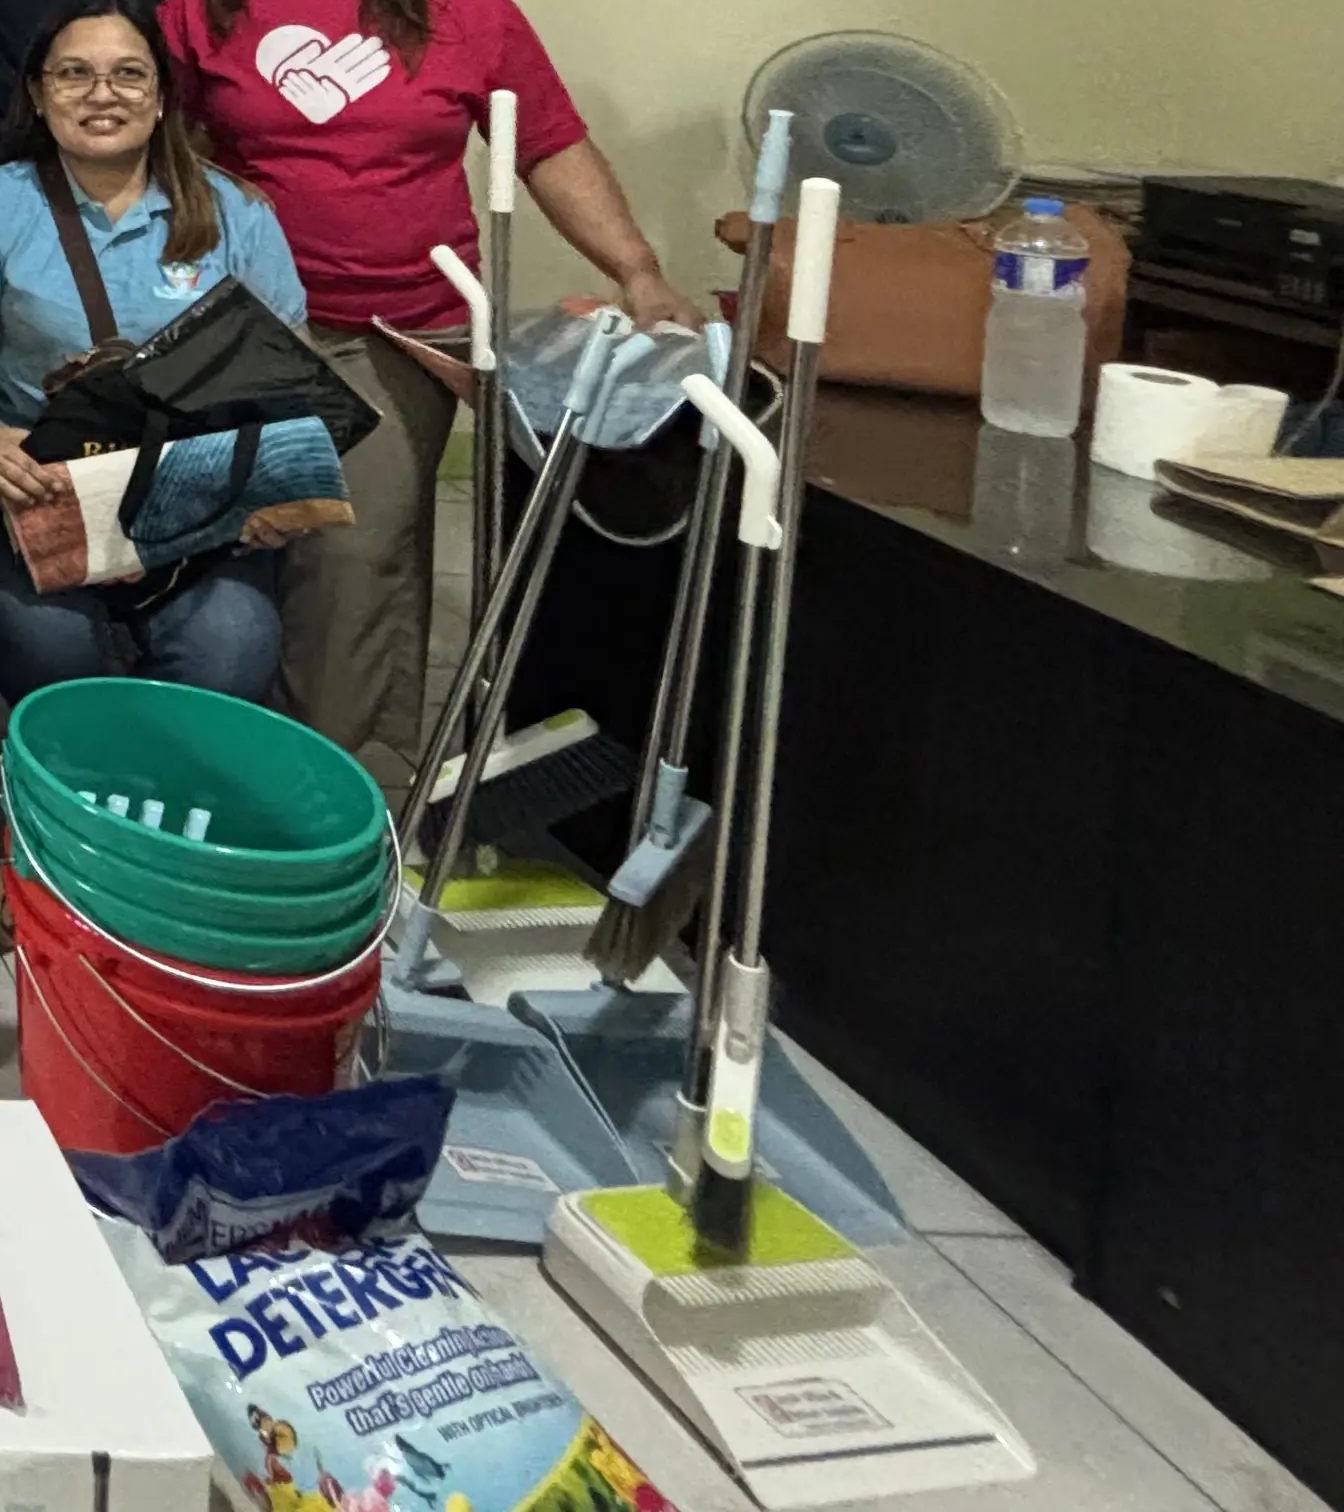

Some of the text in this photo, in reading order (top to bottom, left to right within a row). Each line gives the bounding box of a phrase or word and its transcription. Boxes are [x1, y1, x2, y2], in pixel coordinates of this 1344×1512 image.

[307, 1350, 397, 1412] Powerful
[396, 1327, 477, 1376] Cleaning
[345, 1391, 413, 1436] that's
[412, 1370, 473, 1417] gentle
[437, 1421, 468, 1442] WITH
[467, 1406, 513, 1432] OPTICAL
